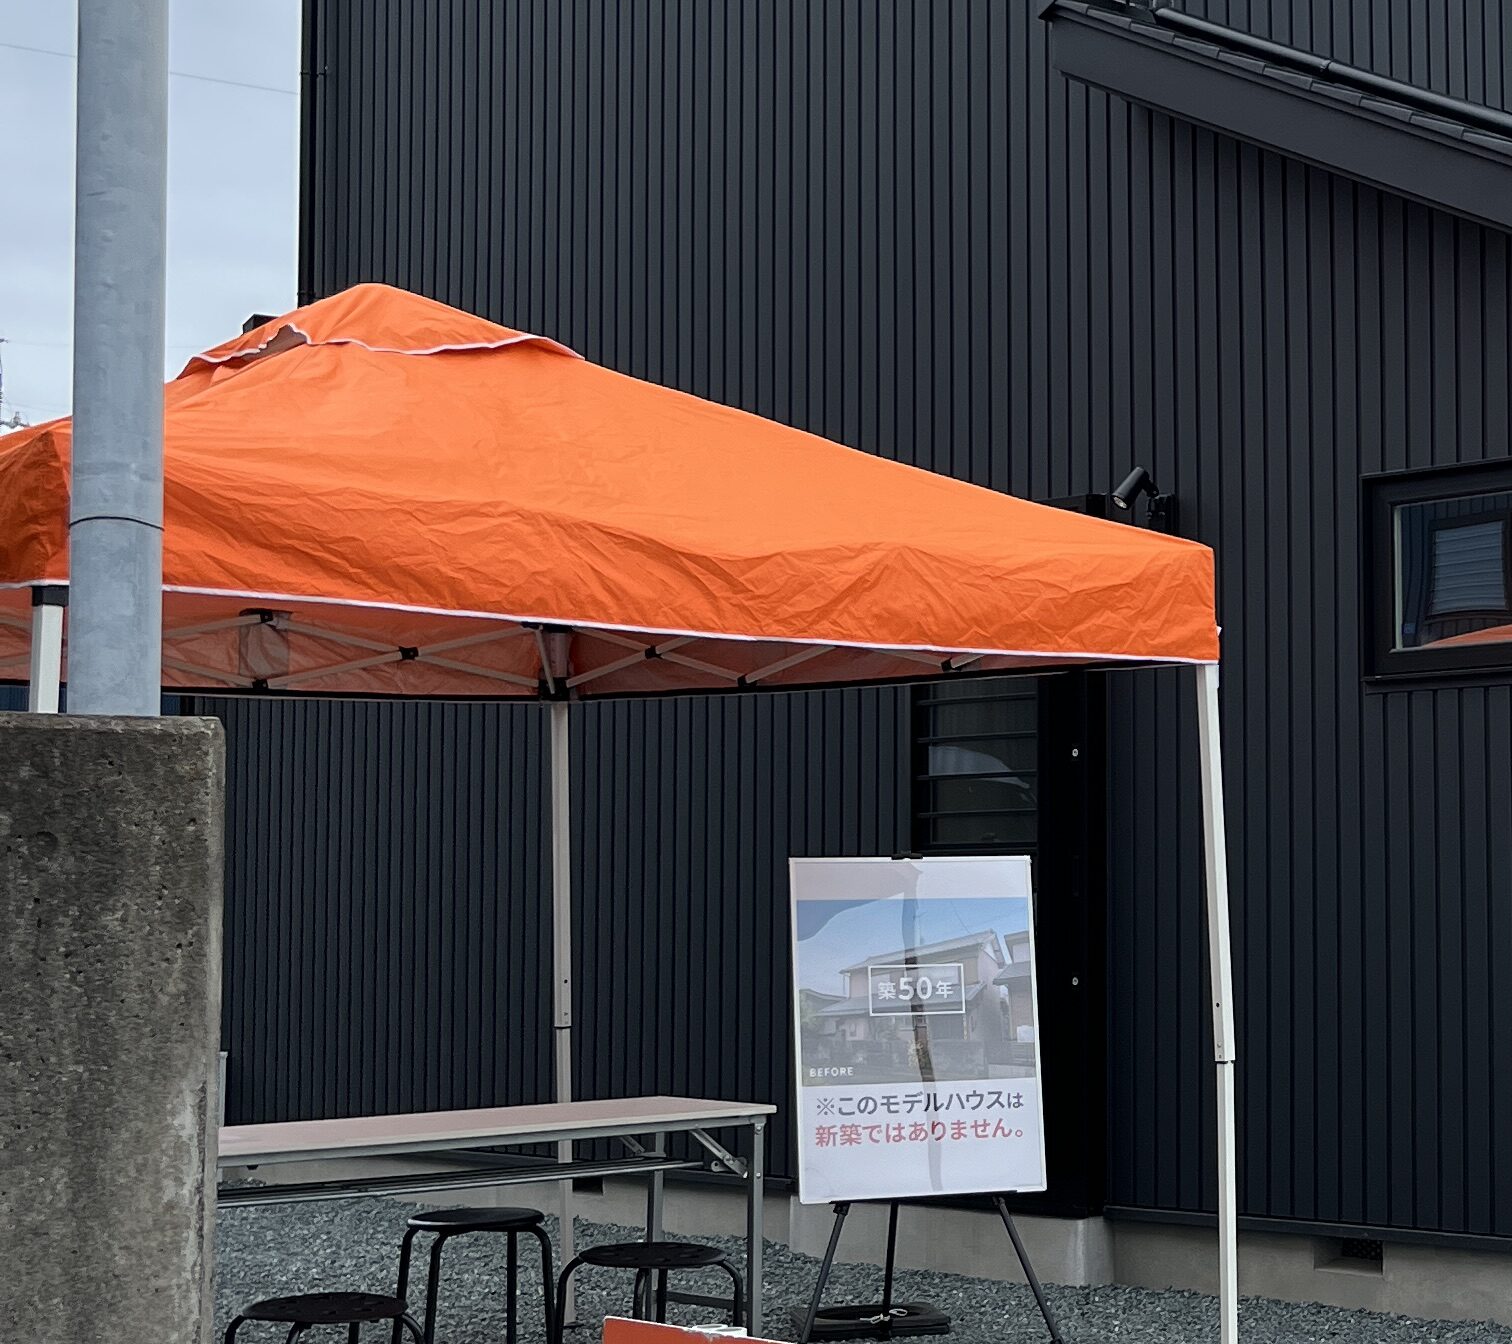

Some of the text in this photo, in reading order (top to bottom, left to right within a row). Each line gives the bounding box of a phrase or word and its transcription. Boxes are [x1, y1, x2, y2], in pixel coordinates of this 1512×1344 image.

[877, 976, 954, 1001] 築50年
[809, 1066, 854, 1078] BEFORE
[815, 1118, 1024, 1147] 新築ではありません。
